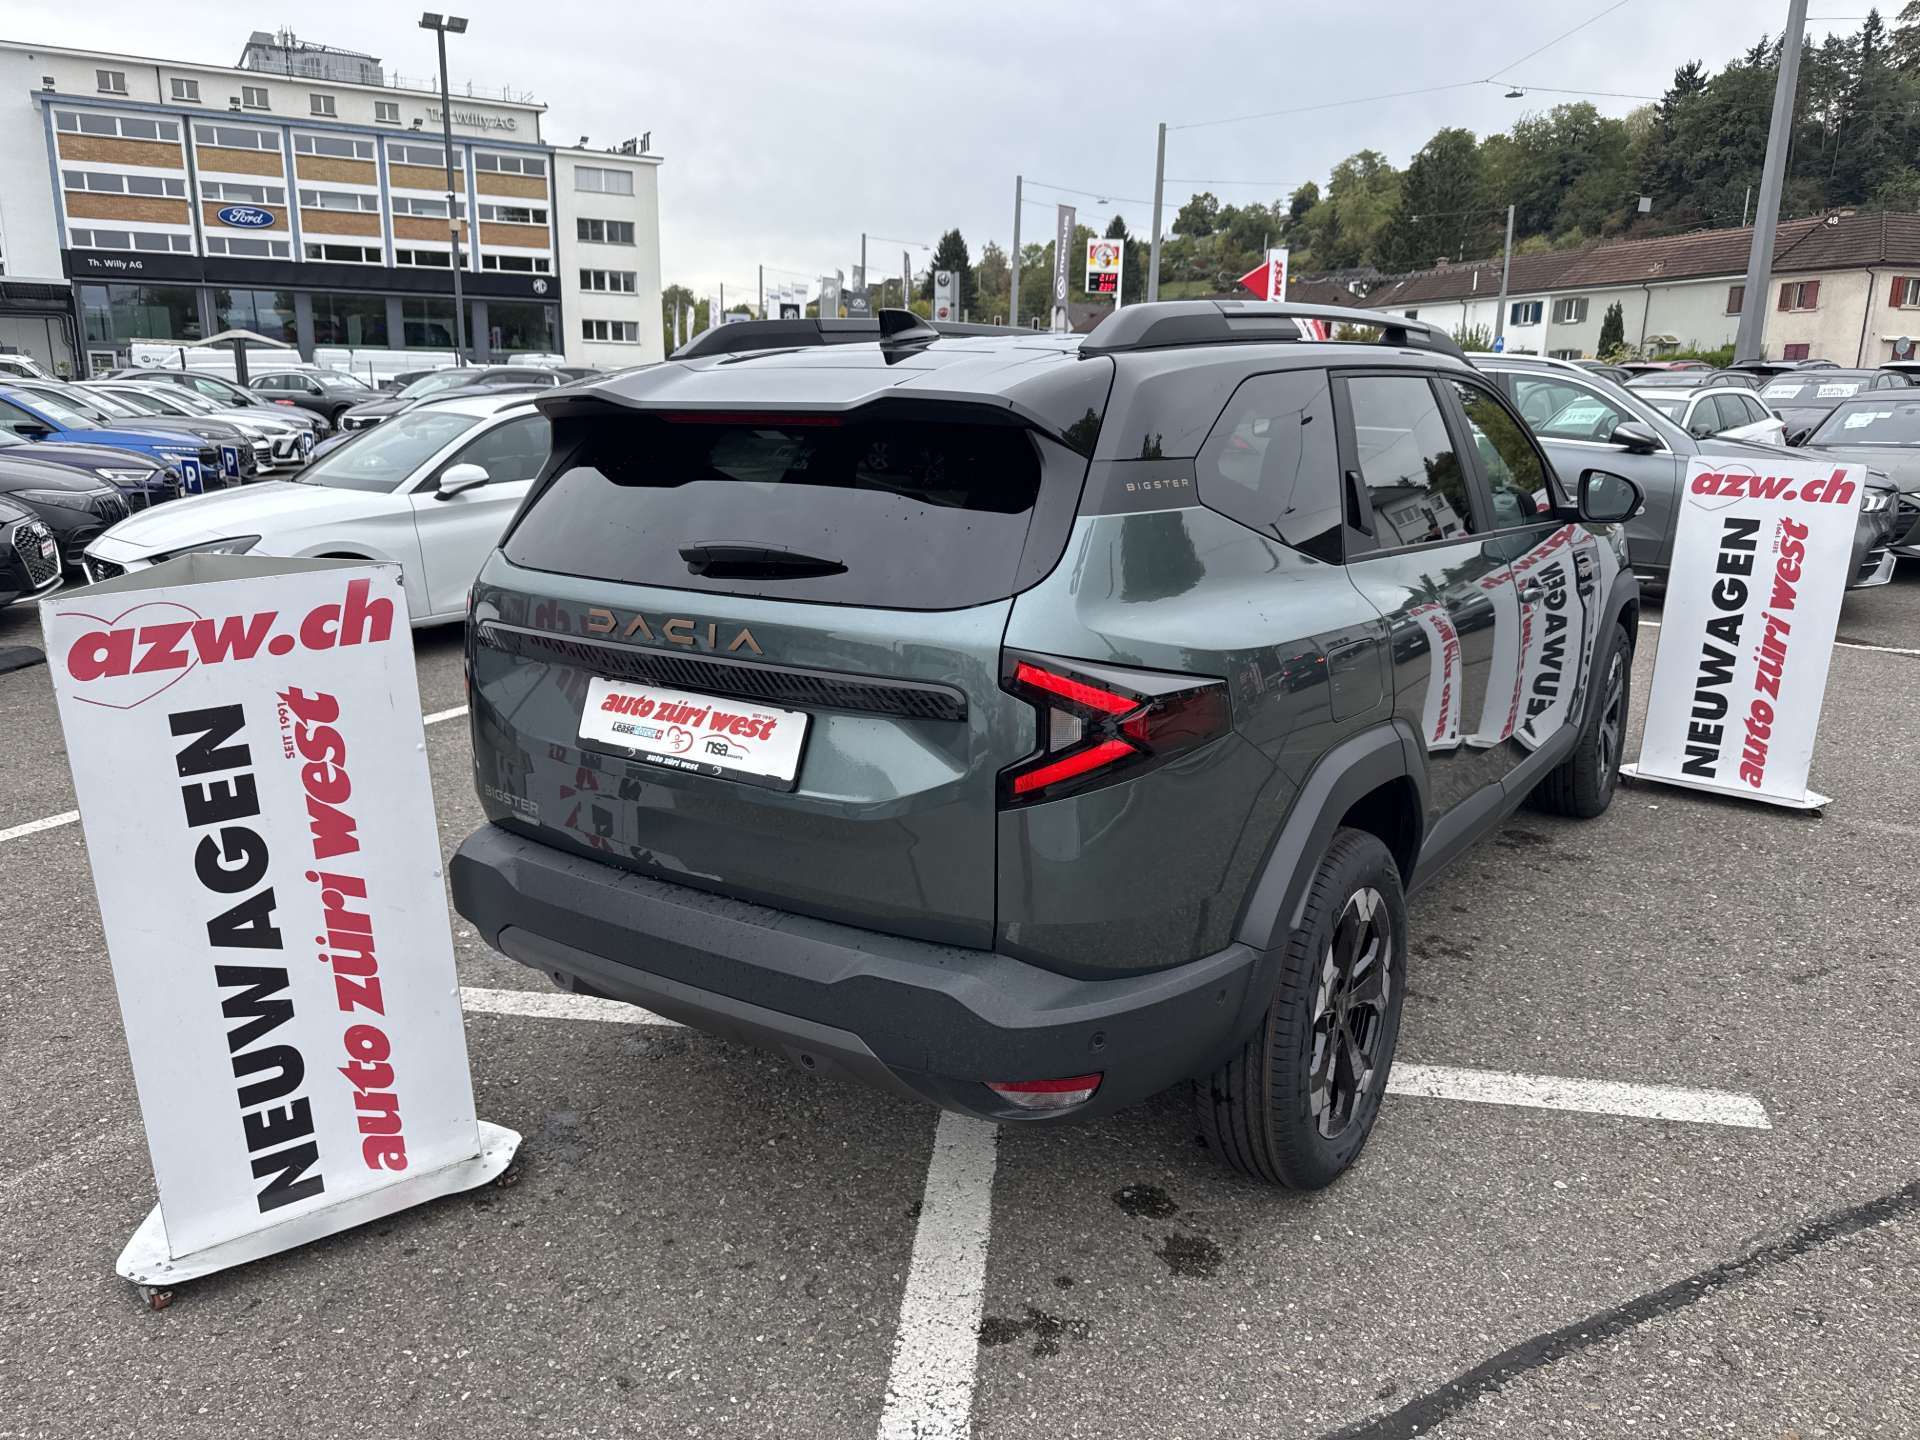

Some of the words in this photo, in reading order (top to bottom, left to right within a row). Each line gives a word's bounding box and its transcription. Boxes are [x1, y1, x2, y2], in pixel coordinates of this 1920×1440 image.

[455, 111, 489, 132] Willy
[494, 115, 517, 131] AG
[229, 207, 263, 225] Ford
[1827, 216, 1839, 225] 48
[88, 258, 102, 267] Th.
[104, 259, 127, 270] Willy
[129, 260, 143, 269] AG
[186, 466, 196, 489] P
[225, 453, 235, 473] P
[1126, 478, 1189, 492] BIGSTER
[1691, 469, 1857, 504] azw.ch
[1774, 522, 1783, 539] 1991
[1771, 539, 1781, 554] SEIT
[1769, 516, 1810, 611] west
[67, 578, 394, 682] azw.ch
[587, 607, 764, 657] DACIA
[1681, 517, 1761, 779] NEUWAGEN
[1752, 611, 1793, 702] züri
[278, 702, 291, 729] 1991
[600, 693, 656, 719] auto
[652, 699, 712, 728] züri
[708, 710, 778, 741] west
[284, 730, 296, 760] SEIT
[705, 741, 728, 757] nsa
[1739, 699, 1775, 789] auto
[277, 685, 361, 859] west
[646, 753, 663, 763] auto
[680, 761, 699, 771] west
[484, 784, 539, 816] BIGSTER
[169, 703, 326, 1214] NEUWAGEN
[305, 871, 386, 1016] züri
[338, 1023, 409, 1173] auto
